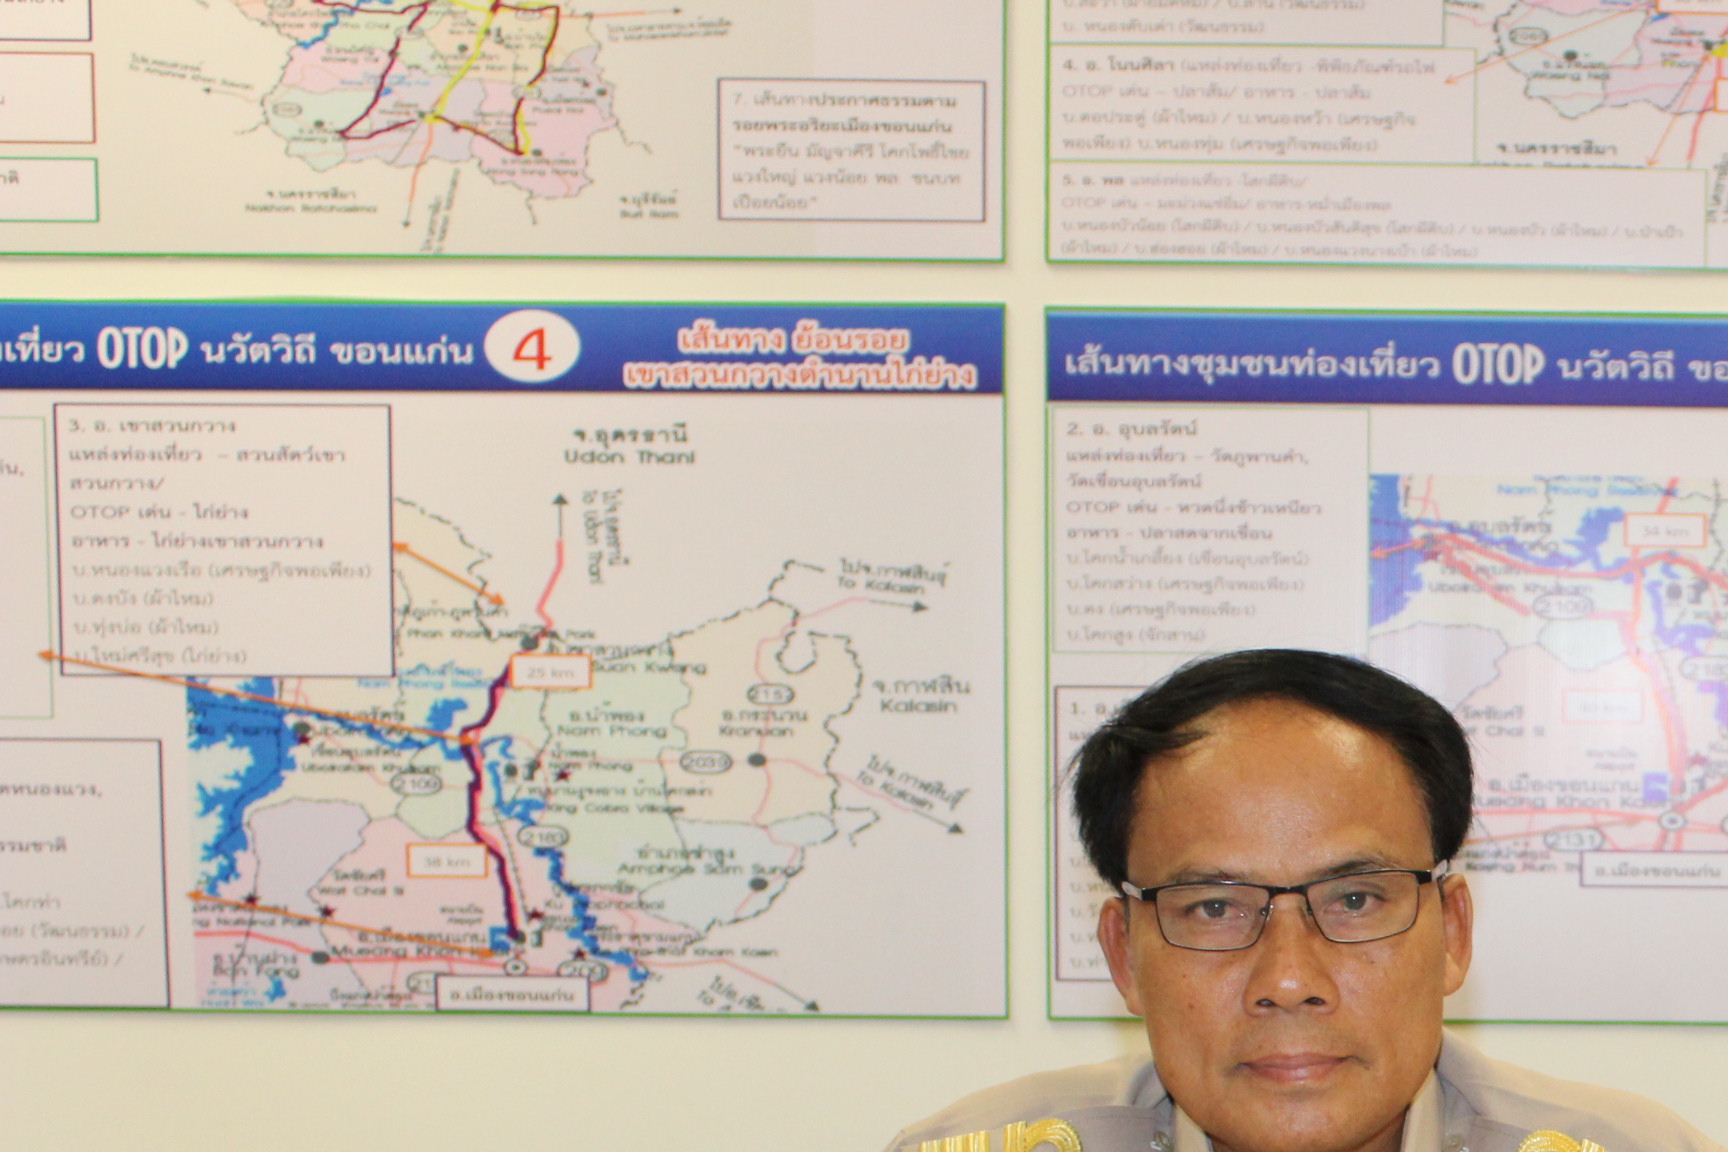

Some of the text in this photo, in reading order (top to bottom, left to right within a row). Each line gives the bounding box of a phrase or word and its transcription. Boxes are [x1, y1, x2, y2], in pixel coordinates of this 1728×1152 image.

[0, 323, 475, 372] เที่ยว OTOP นวัตวิถี ขอนแก่น
[512, 327, 552, 371] 4
[677, 318, 911, 354] เส้นทาง ย้อนรอย
[622, 353, 978, 391] เขาสวนกวางตำนานไก่ย่าง
[1064, 339, 1442, 387] เส้นทางชุมชนท่องเที่ยว
[1452, 341, 1547, 386] OTOP
[1556, 347, 1676, 382] นวัตวิถี
[68, 418, 85, 433] 3.
[119, 420, 237, 433] เขาสวนกวาง
[1066, 421, 1084, 437] 2.
[564, 449, 625, 465] Udon
[70, 504, 131, 520] OTOP
[1066, 500, 1121, 514] OTOP
[71, 535, 131, 549] อาหาร
